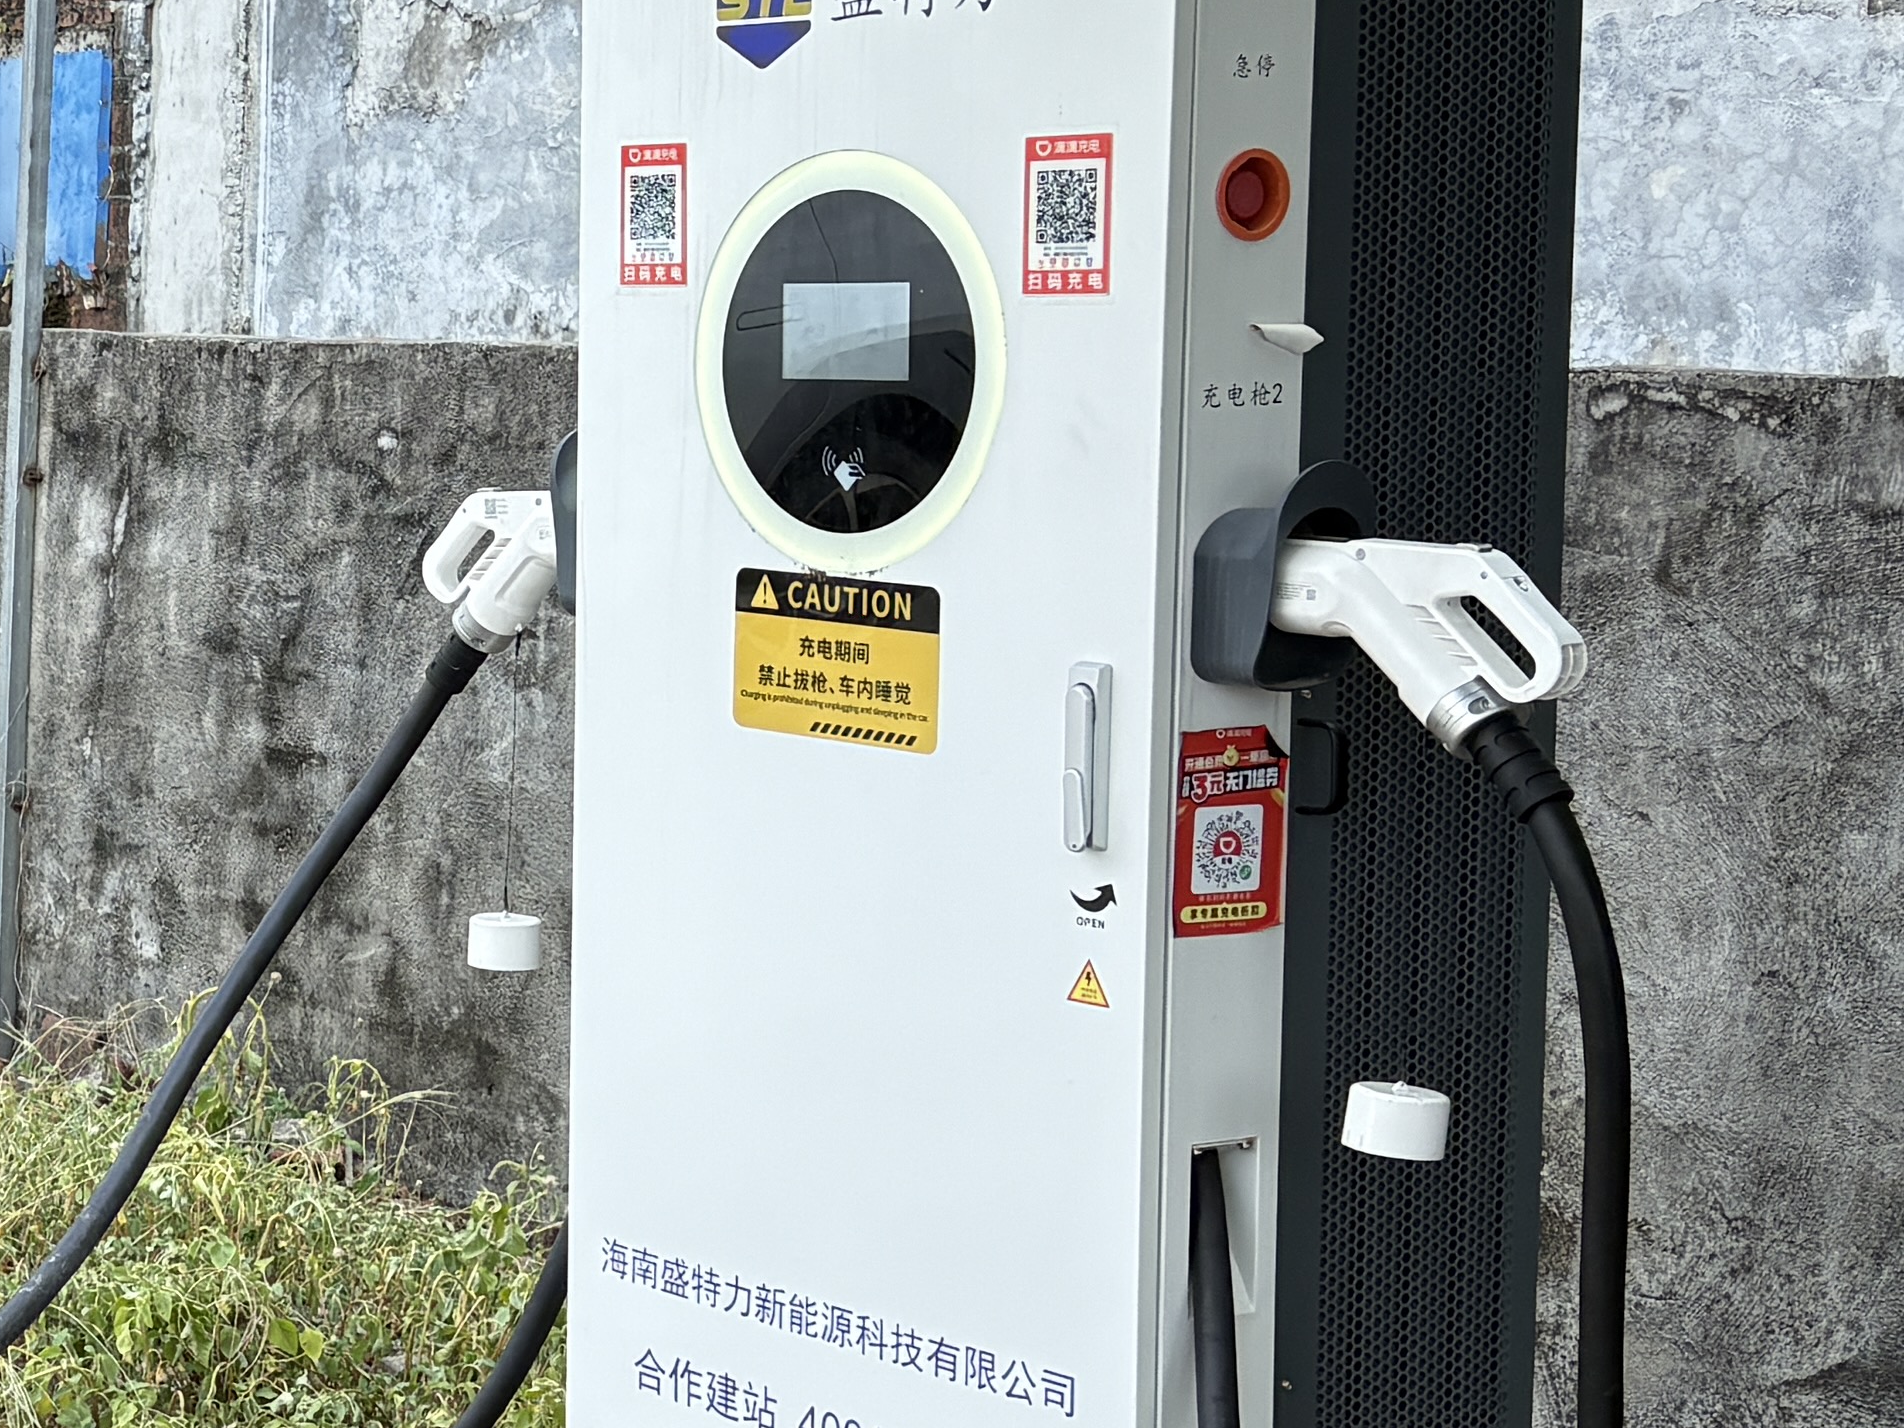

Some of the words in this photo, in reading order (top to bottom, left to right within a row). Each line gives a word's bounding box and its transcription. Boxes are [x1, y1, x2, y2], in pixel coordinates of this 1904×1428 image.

[1232, 53, 1276, 79] 急停
[623, 265, 683, 282] 扫码充电
[1027, 272, 1104, 291] 扫码充电
[1201, 382, 1284, 409] 充电枪2
[787, 580, 912, 621] CAUTION
[798, 635, 870, 665] 充电期间
[758, 664, 912, 705] 禁止拔枪、车内睡觉
[1076, 916, 1105, 930] OPEN
[600, 1236, 1077, 1419] 海南盛特力新能源科技有限公司
